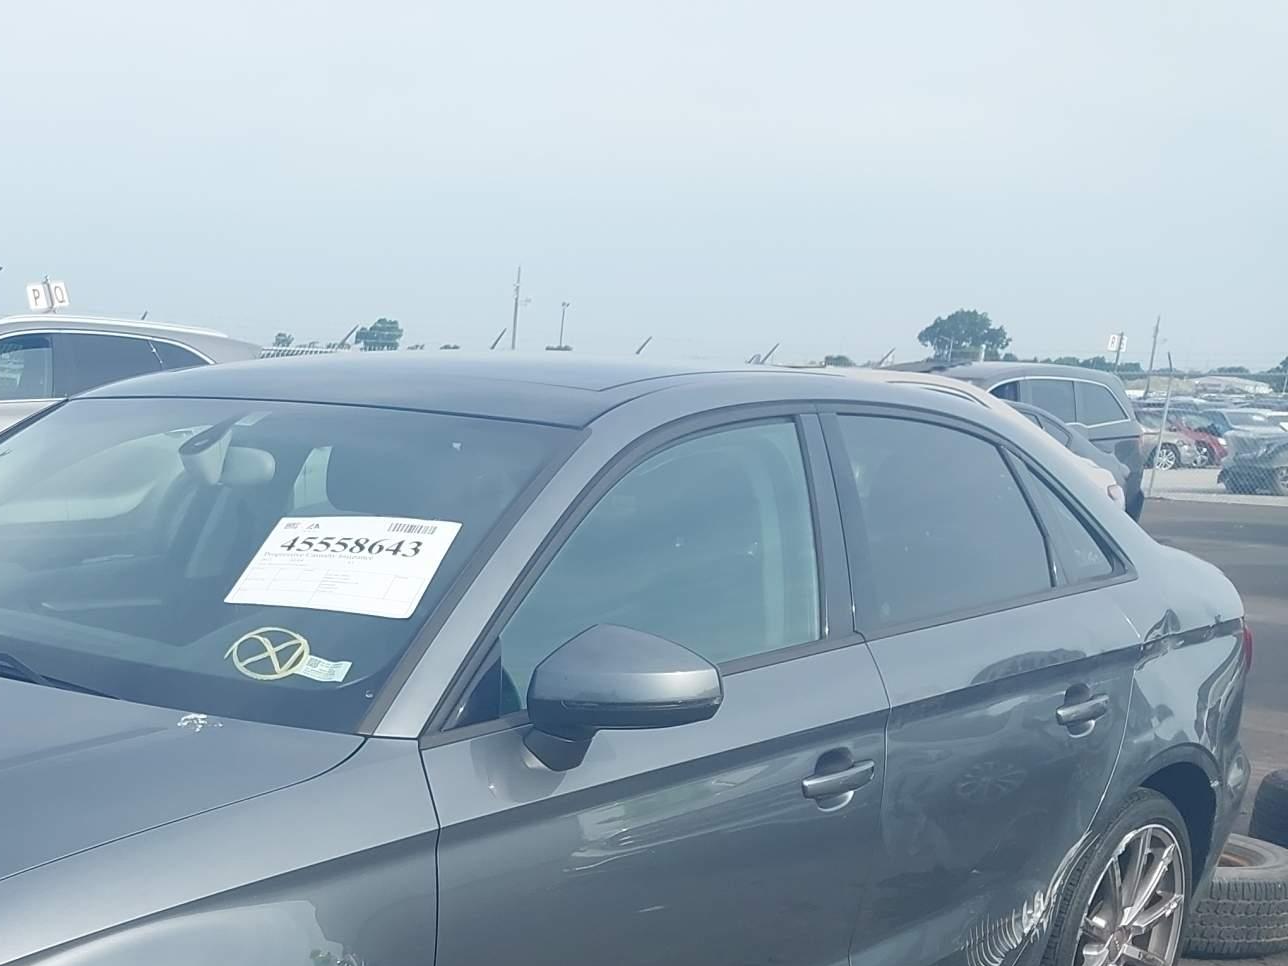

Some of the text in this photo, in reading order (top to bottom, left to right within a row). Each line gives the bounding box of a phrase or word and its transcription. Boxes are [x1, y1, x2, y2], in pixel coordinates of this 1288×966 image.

[32, 288, 40, 306] P
[54, 285, 66, 304] Q
[280, 536, 423, 558] 45558643
